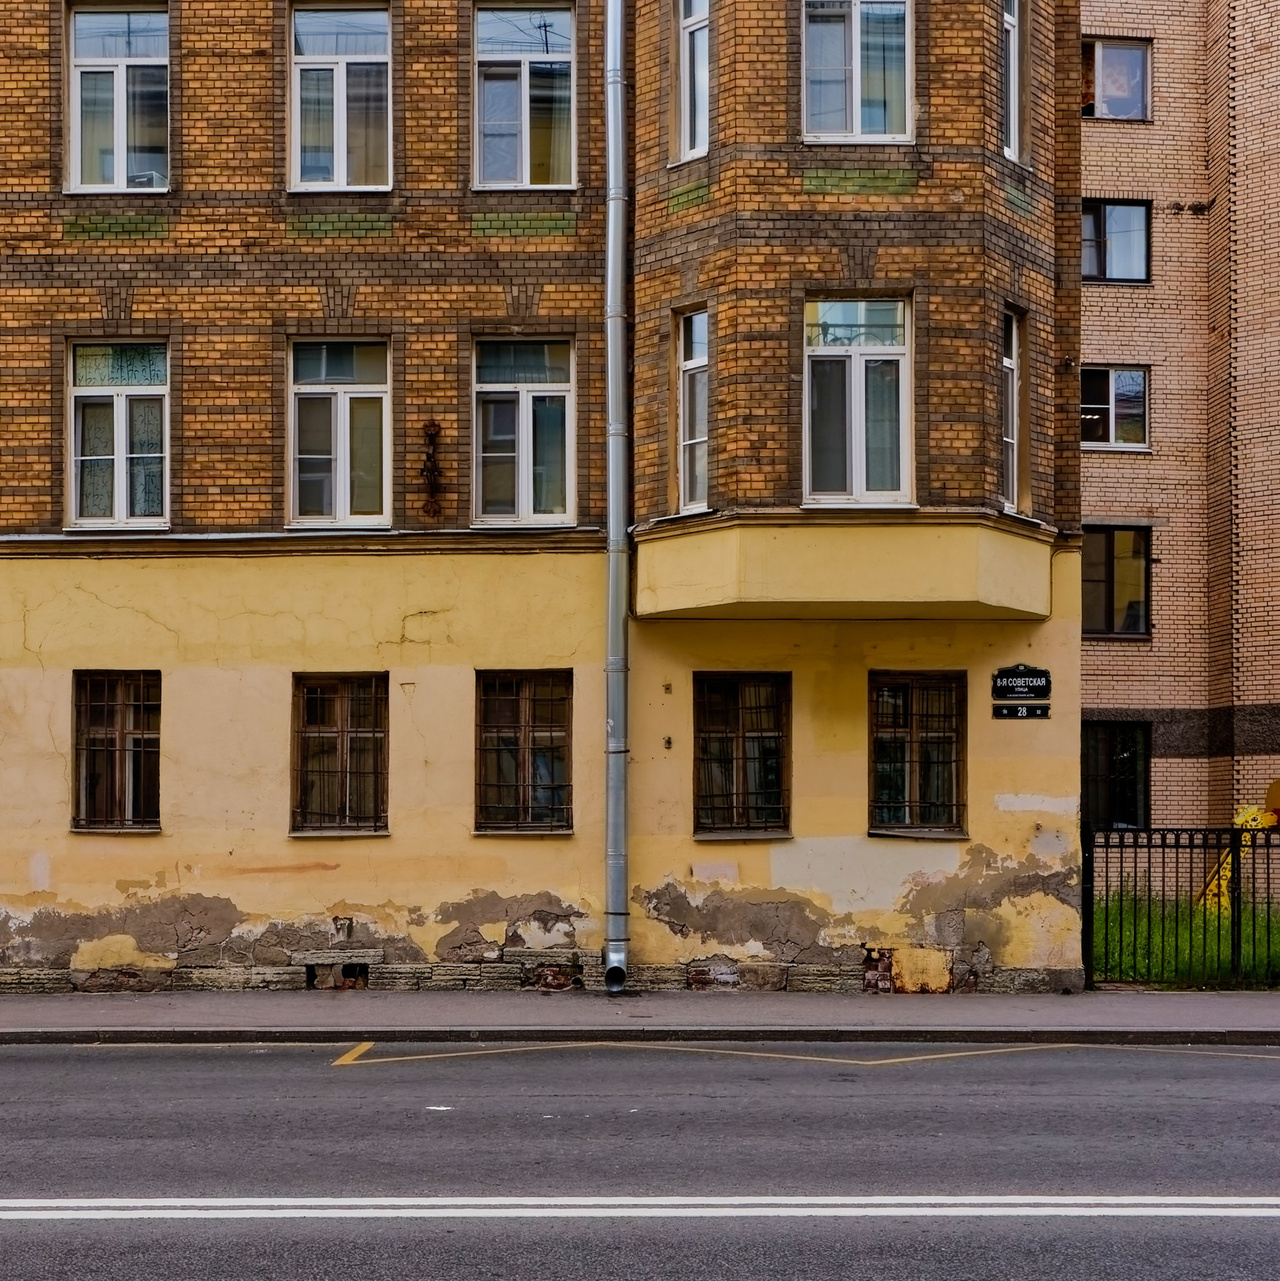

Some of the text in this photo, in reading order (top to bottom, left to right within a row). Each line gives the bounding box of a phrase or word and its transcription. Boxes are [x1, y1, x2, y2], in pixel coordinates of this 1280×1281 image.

[996, 678, 1046, 686] 8-Я СОВЕТСКАЯ
[1017, 707, 1027, 716] 28
